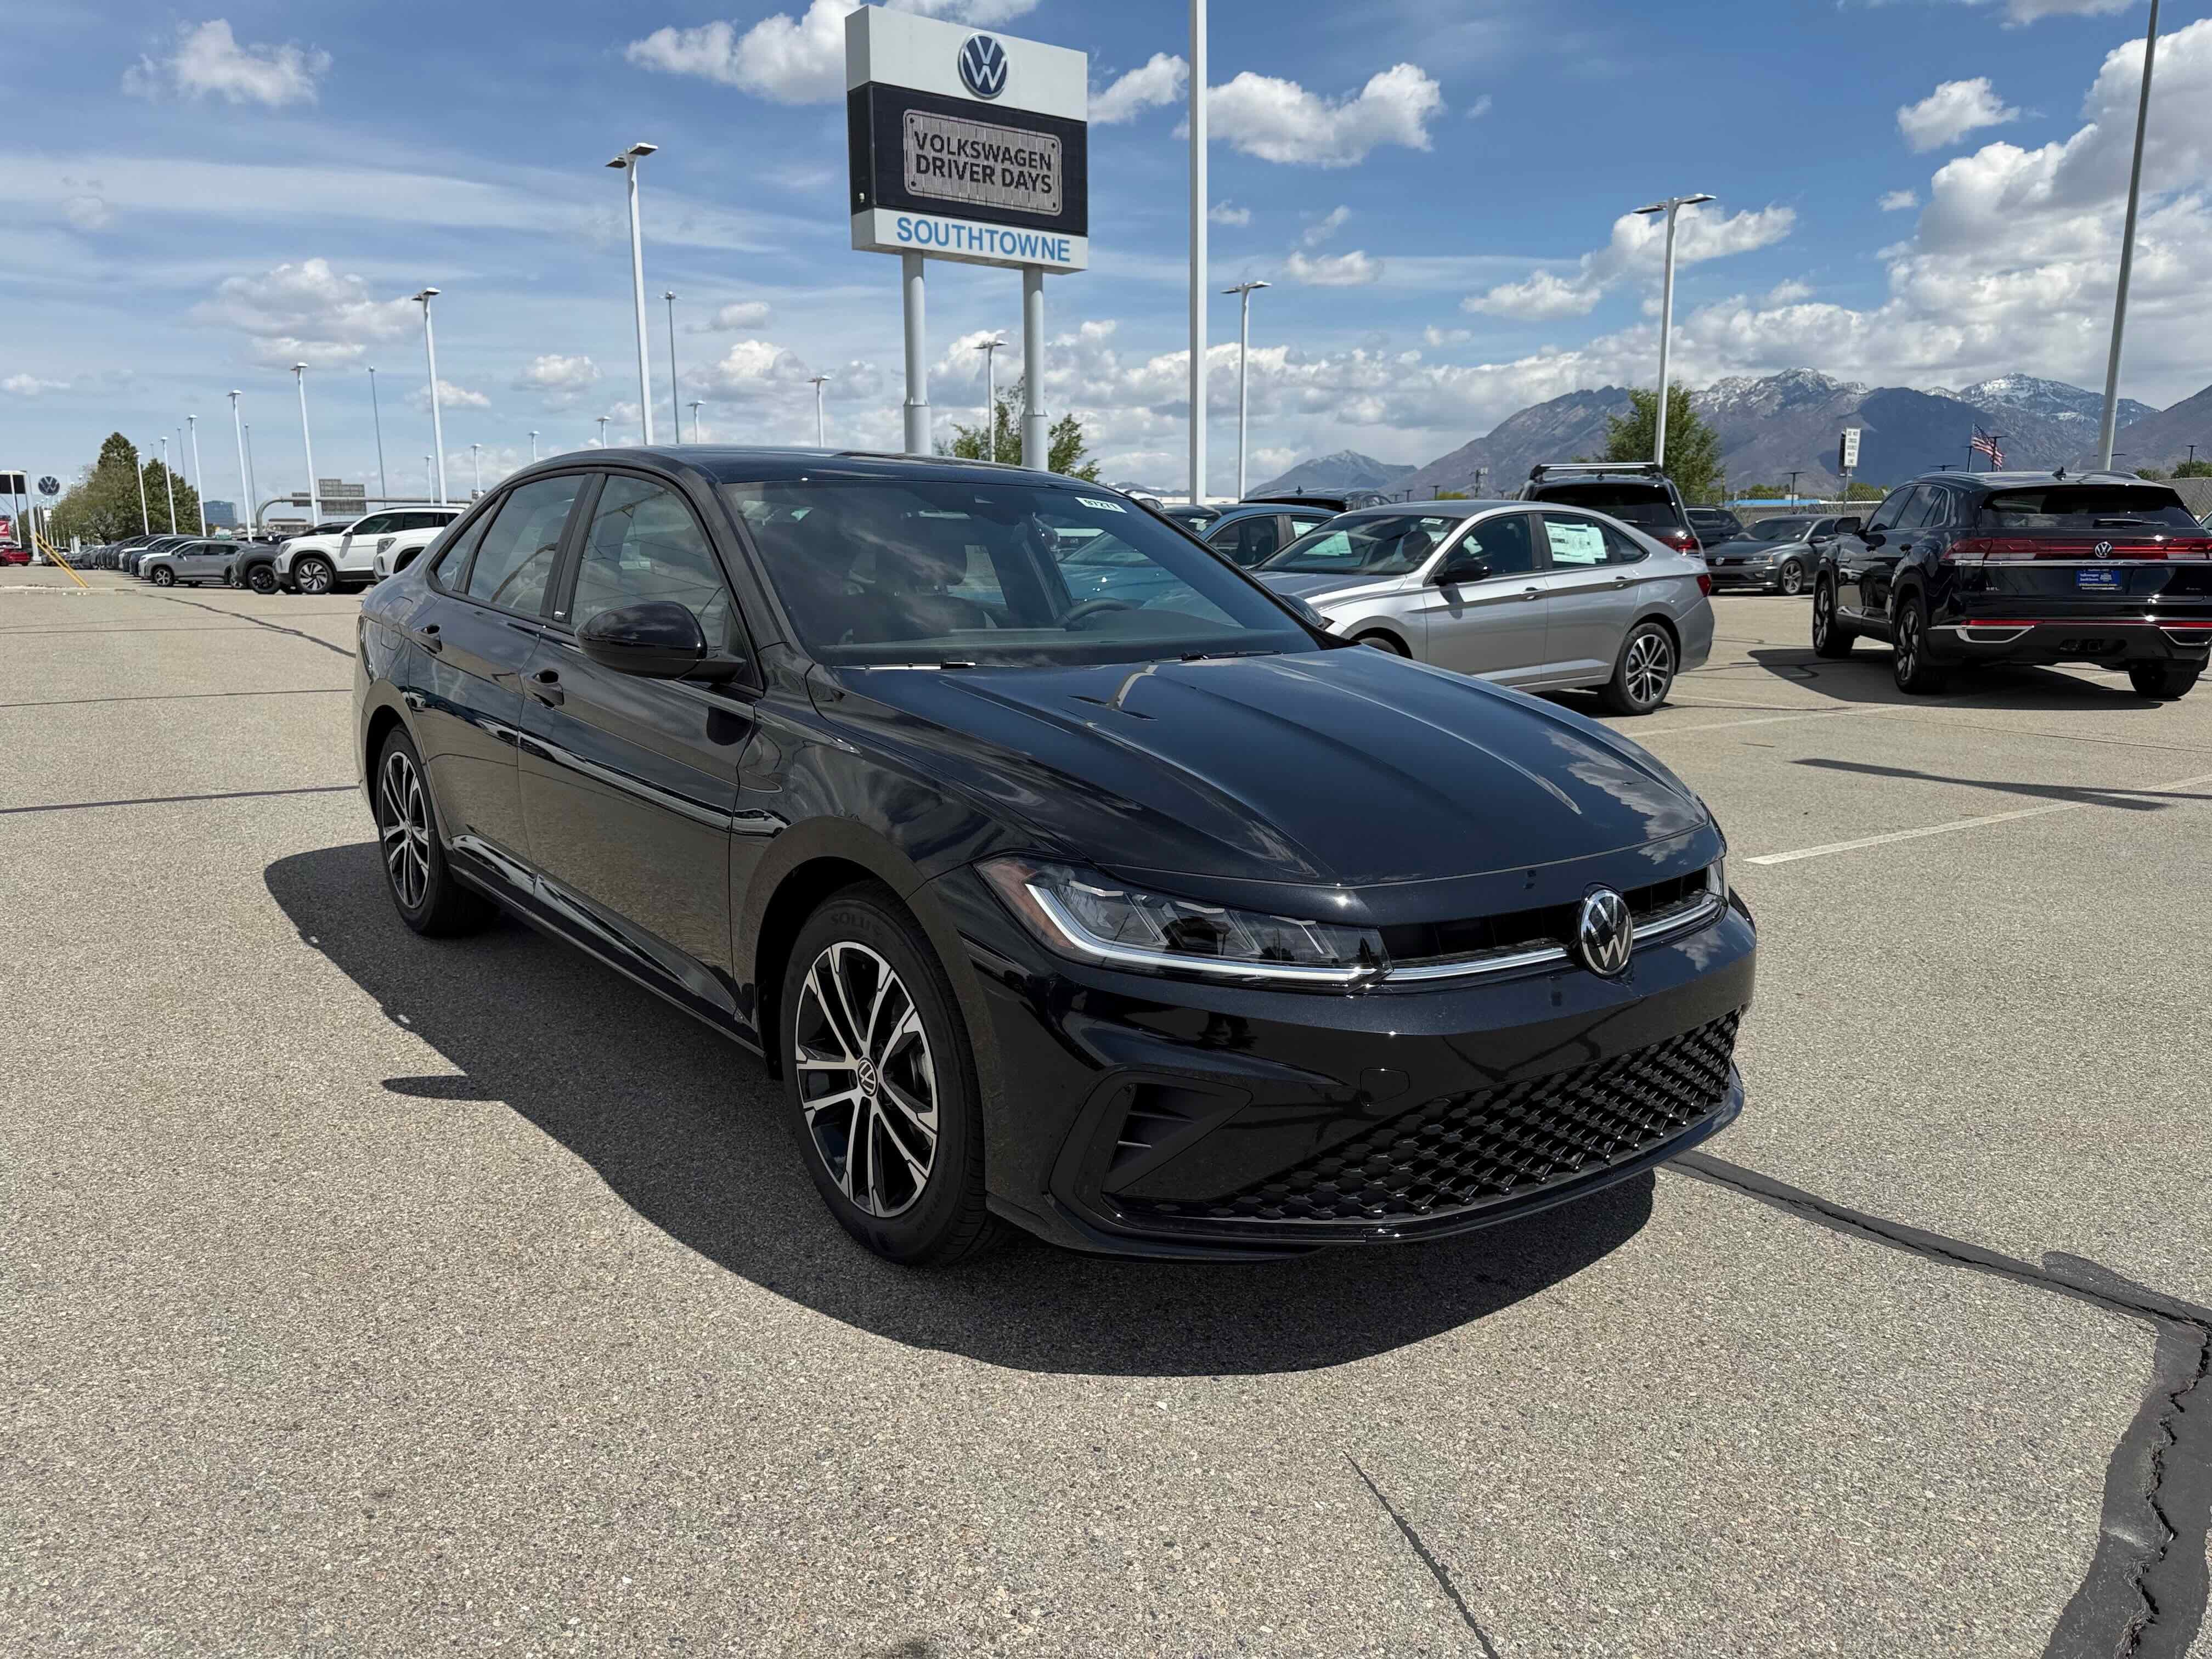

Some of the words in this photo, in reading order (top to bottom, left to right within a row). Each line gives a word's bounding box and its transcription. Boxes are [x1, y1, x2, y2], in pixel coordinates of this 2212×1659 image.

[960, 33, 1008, 98] VW
[913, 131, 1052, 171] VOLKSWAGEN
[916, 154, 995, 185] DRIVER
[1001, 168, 1052, 194] DAYS
[896, 217, 1071, 263] SOUTHTOWNE
[1581, 888, 1633, 975] VW
